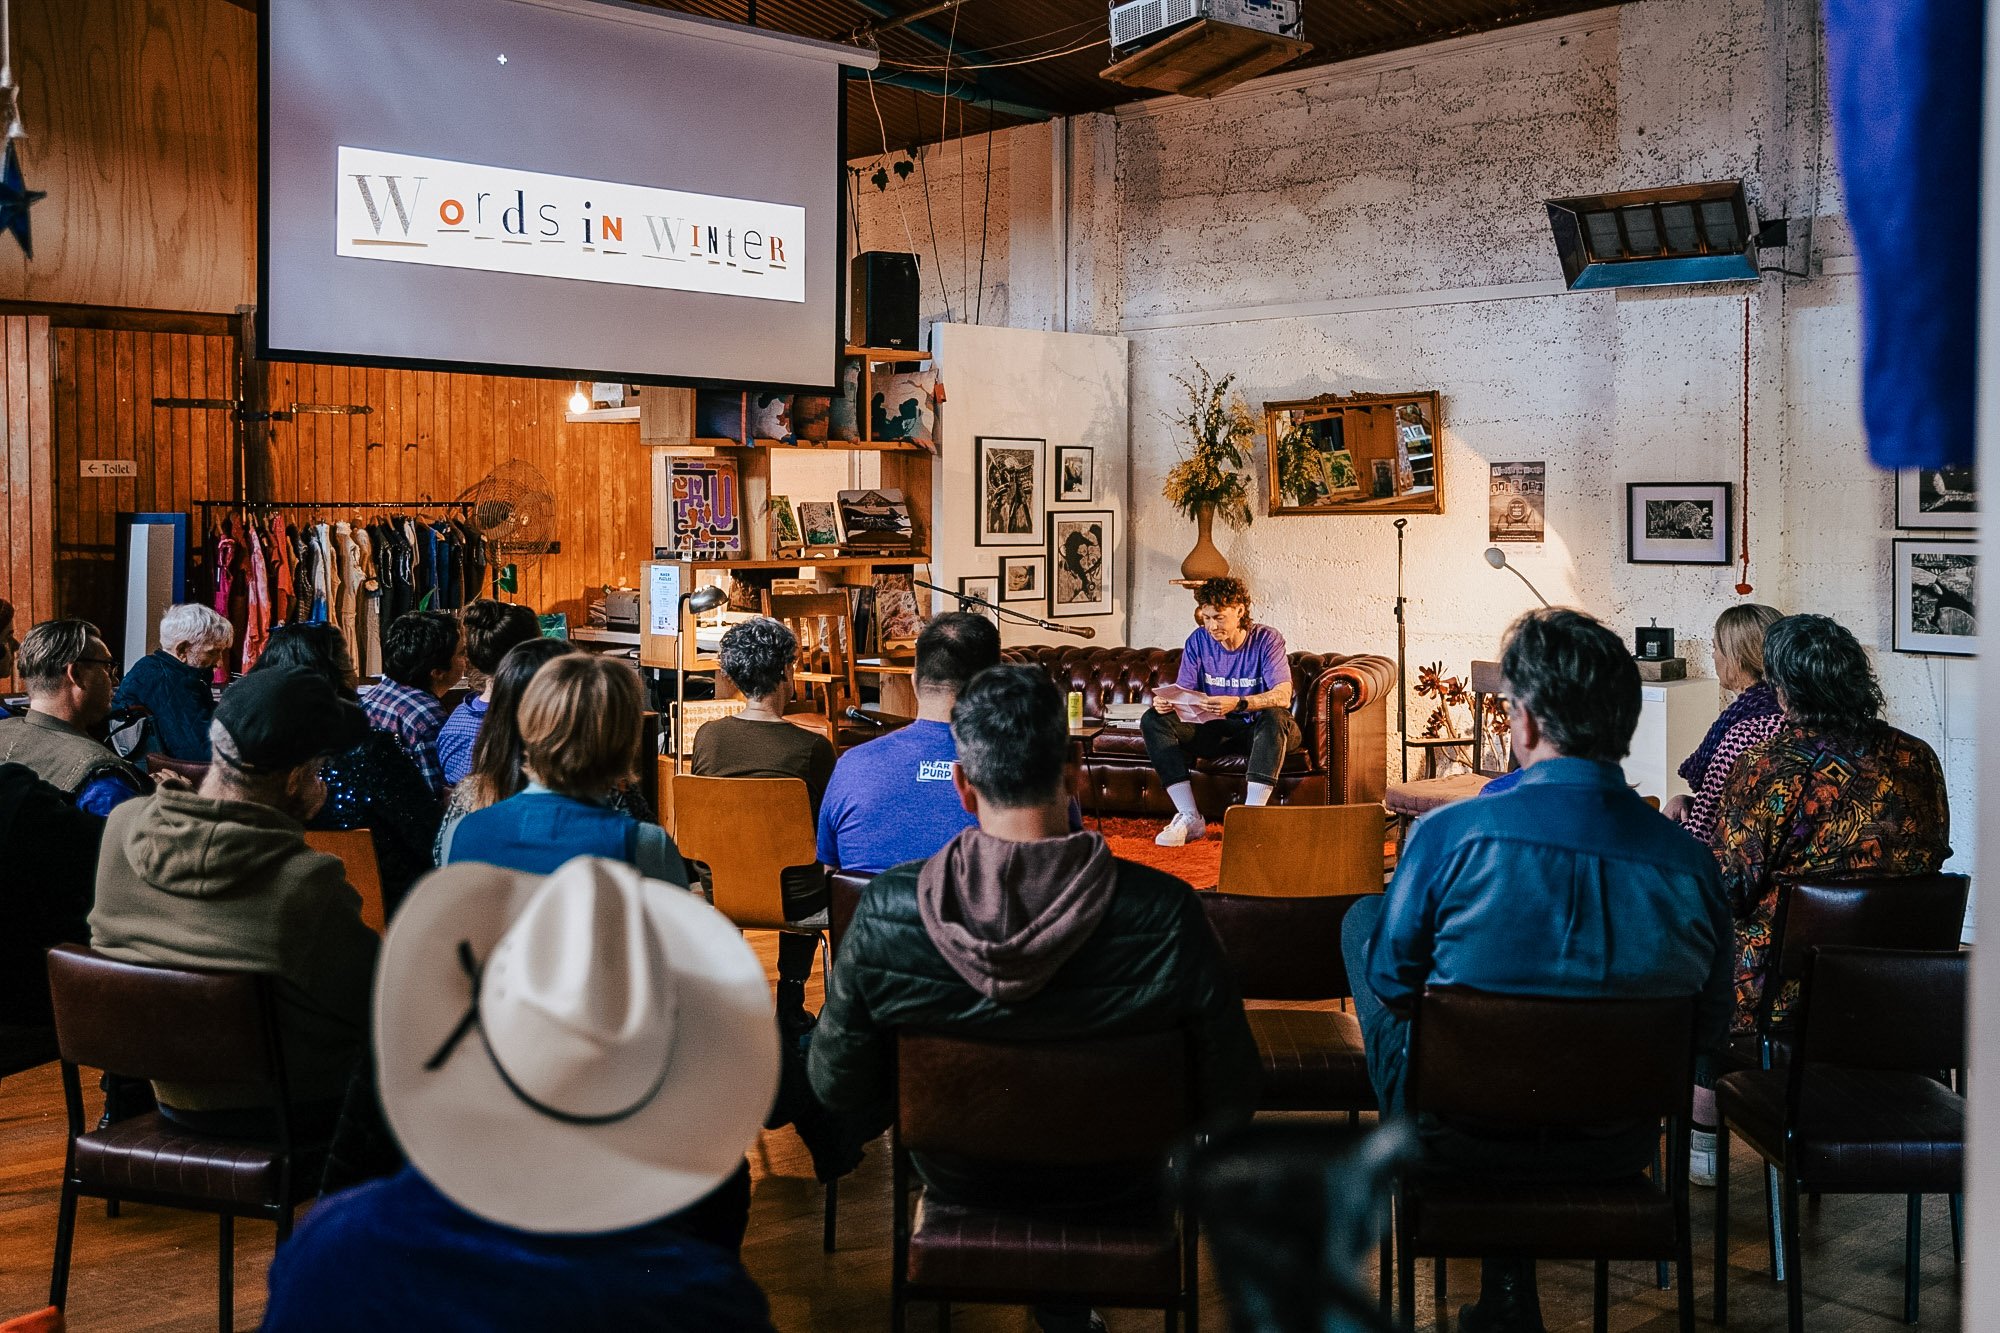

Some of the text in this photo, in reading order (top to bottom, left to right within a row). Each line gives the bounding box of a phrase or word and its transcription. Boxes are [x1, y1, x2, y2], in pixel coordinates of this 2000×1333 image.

[348, 174, 565, 237] Words
[102, 463, 130, 474] Toilet
[922, 760, 950, 769] WEAR
[922, 768, 951, 779] PURP
